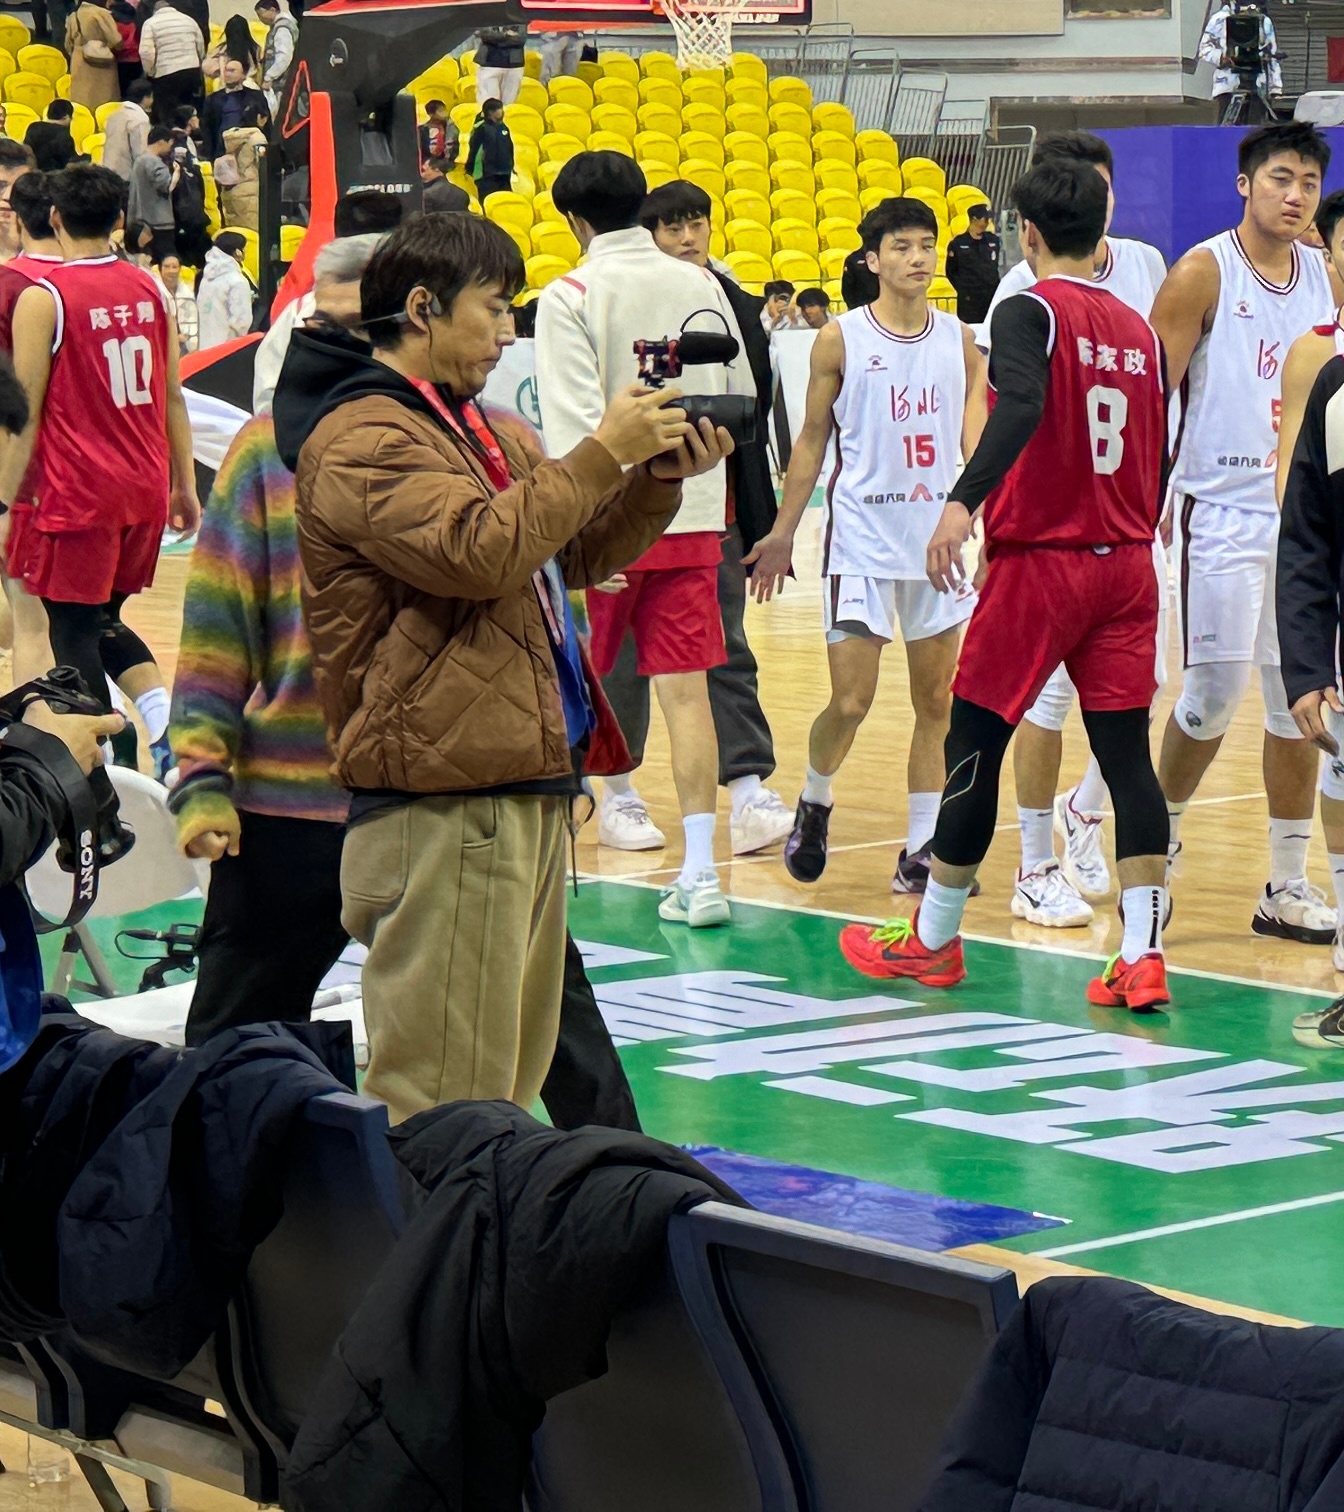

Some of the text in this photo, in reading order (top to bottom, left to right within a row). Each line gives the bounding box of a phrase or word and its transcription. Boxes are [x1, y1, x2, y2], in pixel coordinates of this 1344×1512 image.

[102, 335, 153, 409] 10
[903, 434, 936, 469] 15
[1086, 384, 1128, 476] 8
[79, 829, 94, 899] SONY
